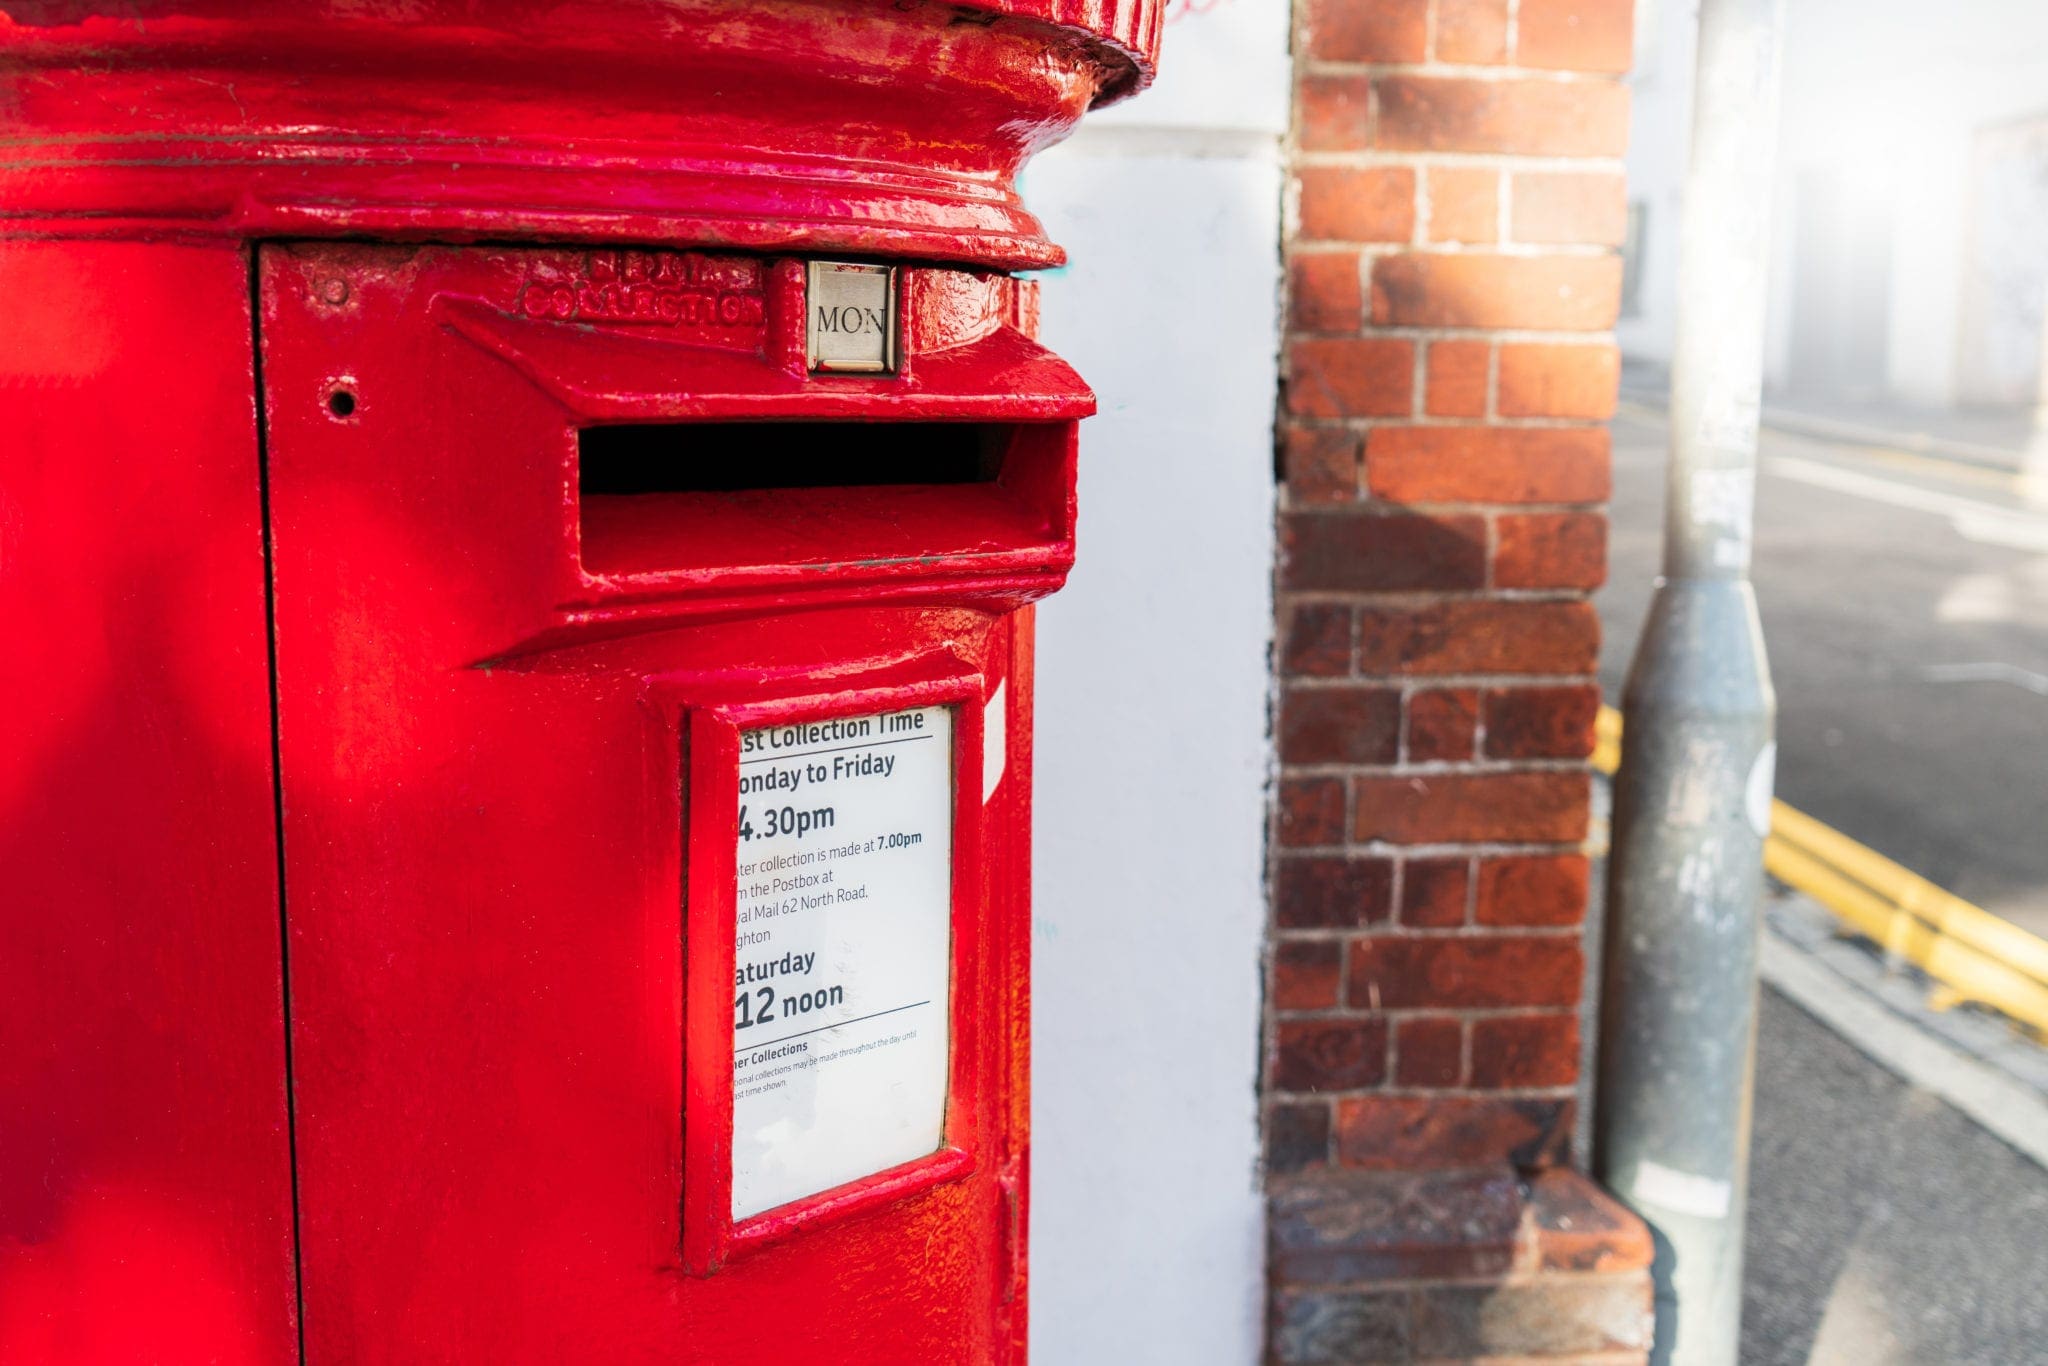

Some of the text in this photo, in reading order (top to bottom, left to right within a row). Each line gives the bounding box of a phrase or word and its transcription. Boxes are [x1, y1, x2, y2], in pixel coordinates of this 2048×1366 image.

[524, 284, 764, 326] COLLECTION
[817, 306, 885, 334] MON
[770, 719, 870, 748] Collection
[878, 711, 924, 733] Time
[739, 753, 895, 794] onday to Friday
[738, 804, 834, 842] 4.30pm
[737, 831, 922, 878] ter collection is made at 7.00pm
[750, 883, 769, 899] the
[773, 874, 819, 894] Postbox
[822, 869, 834, 883] at
[755, 902, 778, 921] Mail
[782, 898, 798, 915] 62
[801, 892, 834, 910] North
[837, 884, 868, 904] Road.
[736, 929, 771, 950] ghton
[735, 951, 815, 986] aturday
[735, 984, 843, 1030] 12 noon
[751, 1041, 808, 1065] Collections
[755, 1065, 792, 1081] collections
[793, 1060, 808, 1073] may
[809, 1056, 817, 1067] be
[819, 1051, 838, 1063] made
[839, 1041, 876, 1057] throughout
[877, 1037, 889, 1048] the
[889, 1033, 901, 1045] day
[745, 1086, 762, 1097] time
